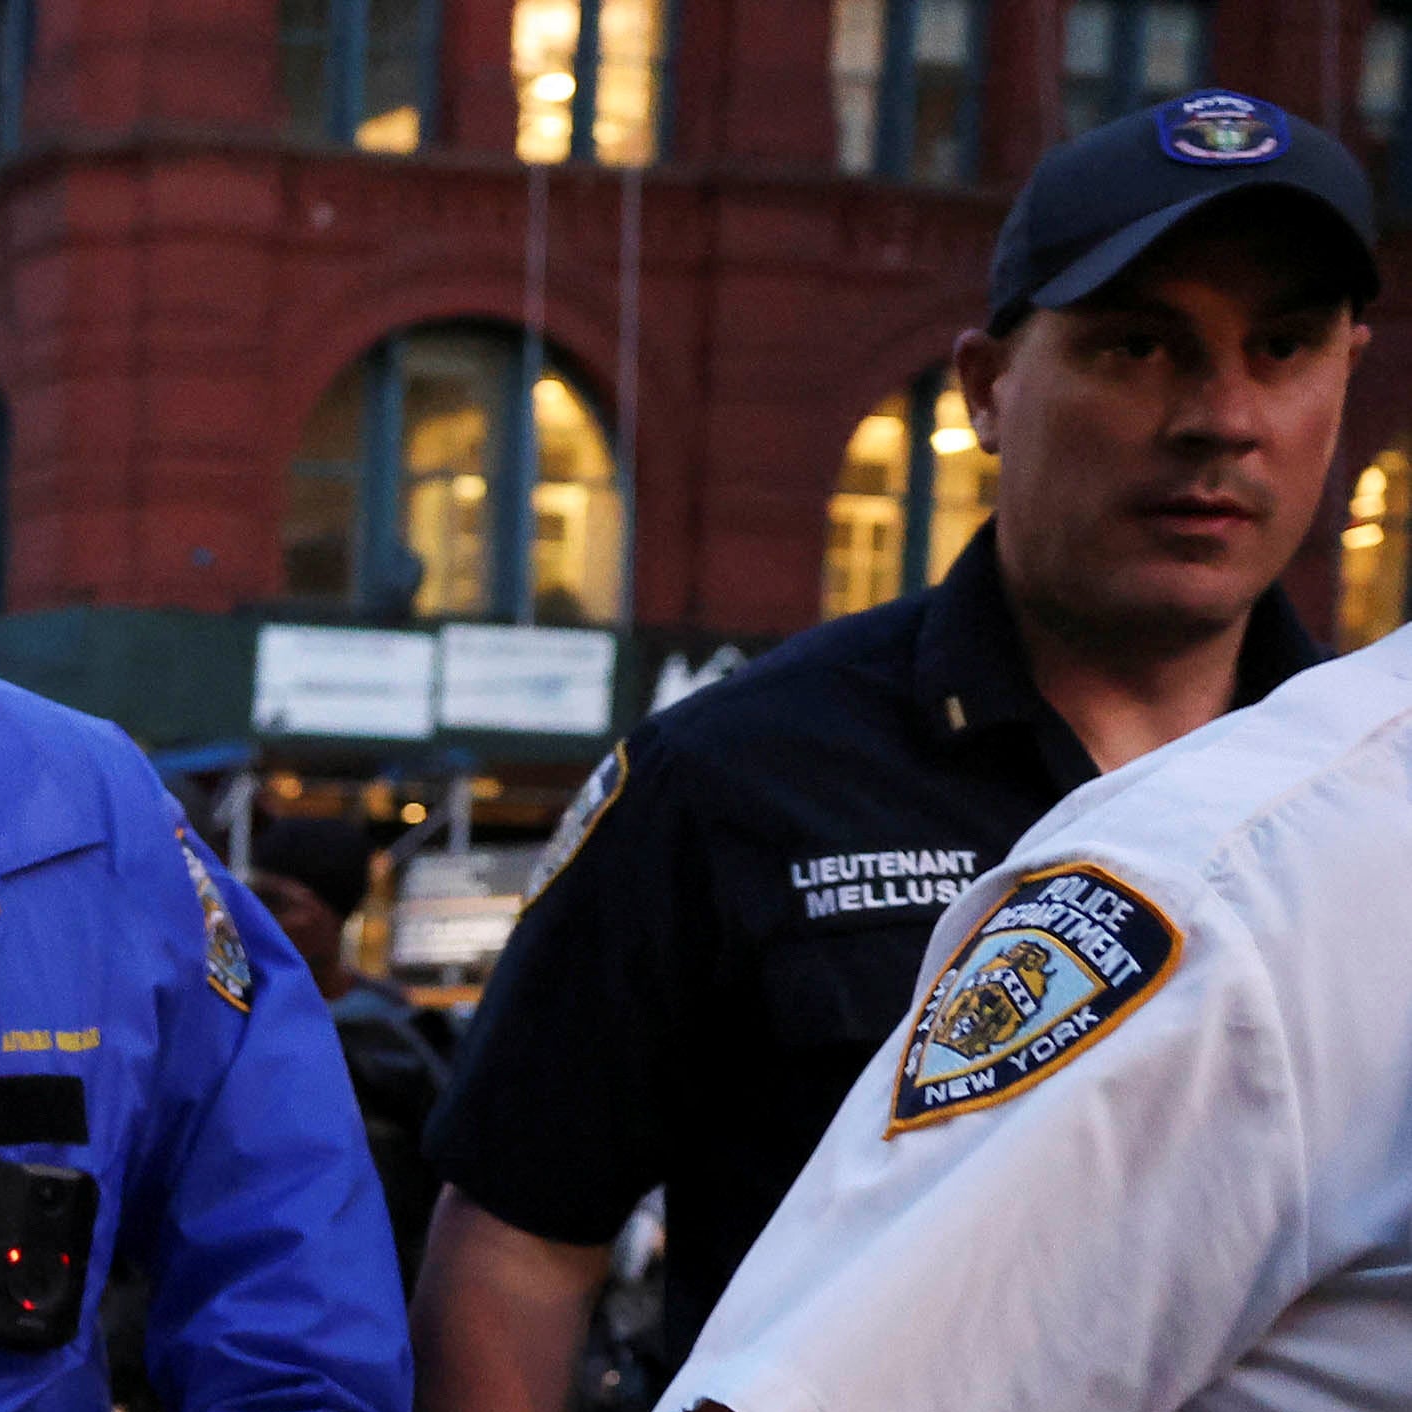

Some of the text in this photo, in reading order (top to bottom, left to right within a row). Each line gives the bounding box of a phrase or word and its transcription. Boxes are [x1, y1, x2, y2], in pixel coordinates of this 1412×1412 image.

[791, 850, 976, 888] LIEUTENANT
[924, 1004, 1100, 1105] NEW YORK
